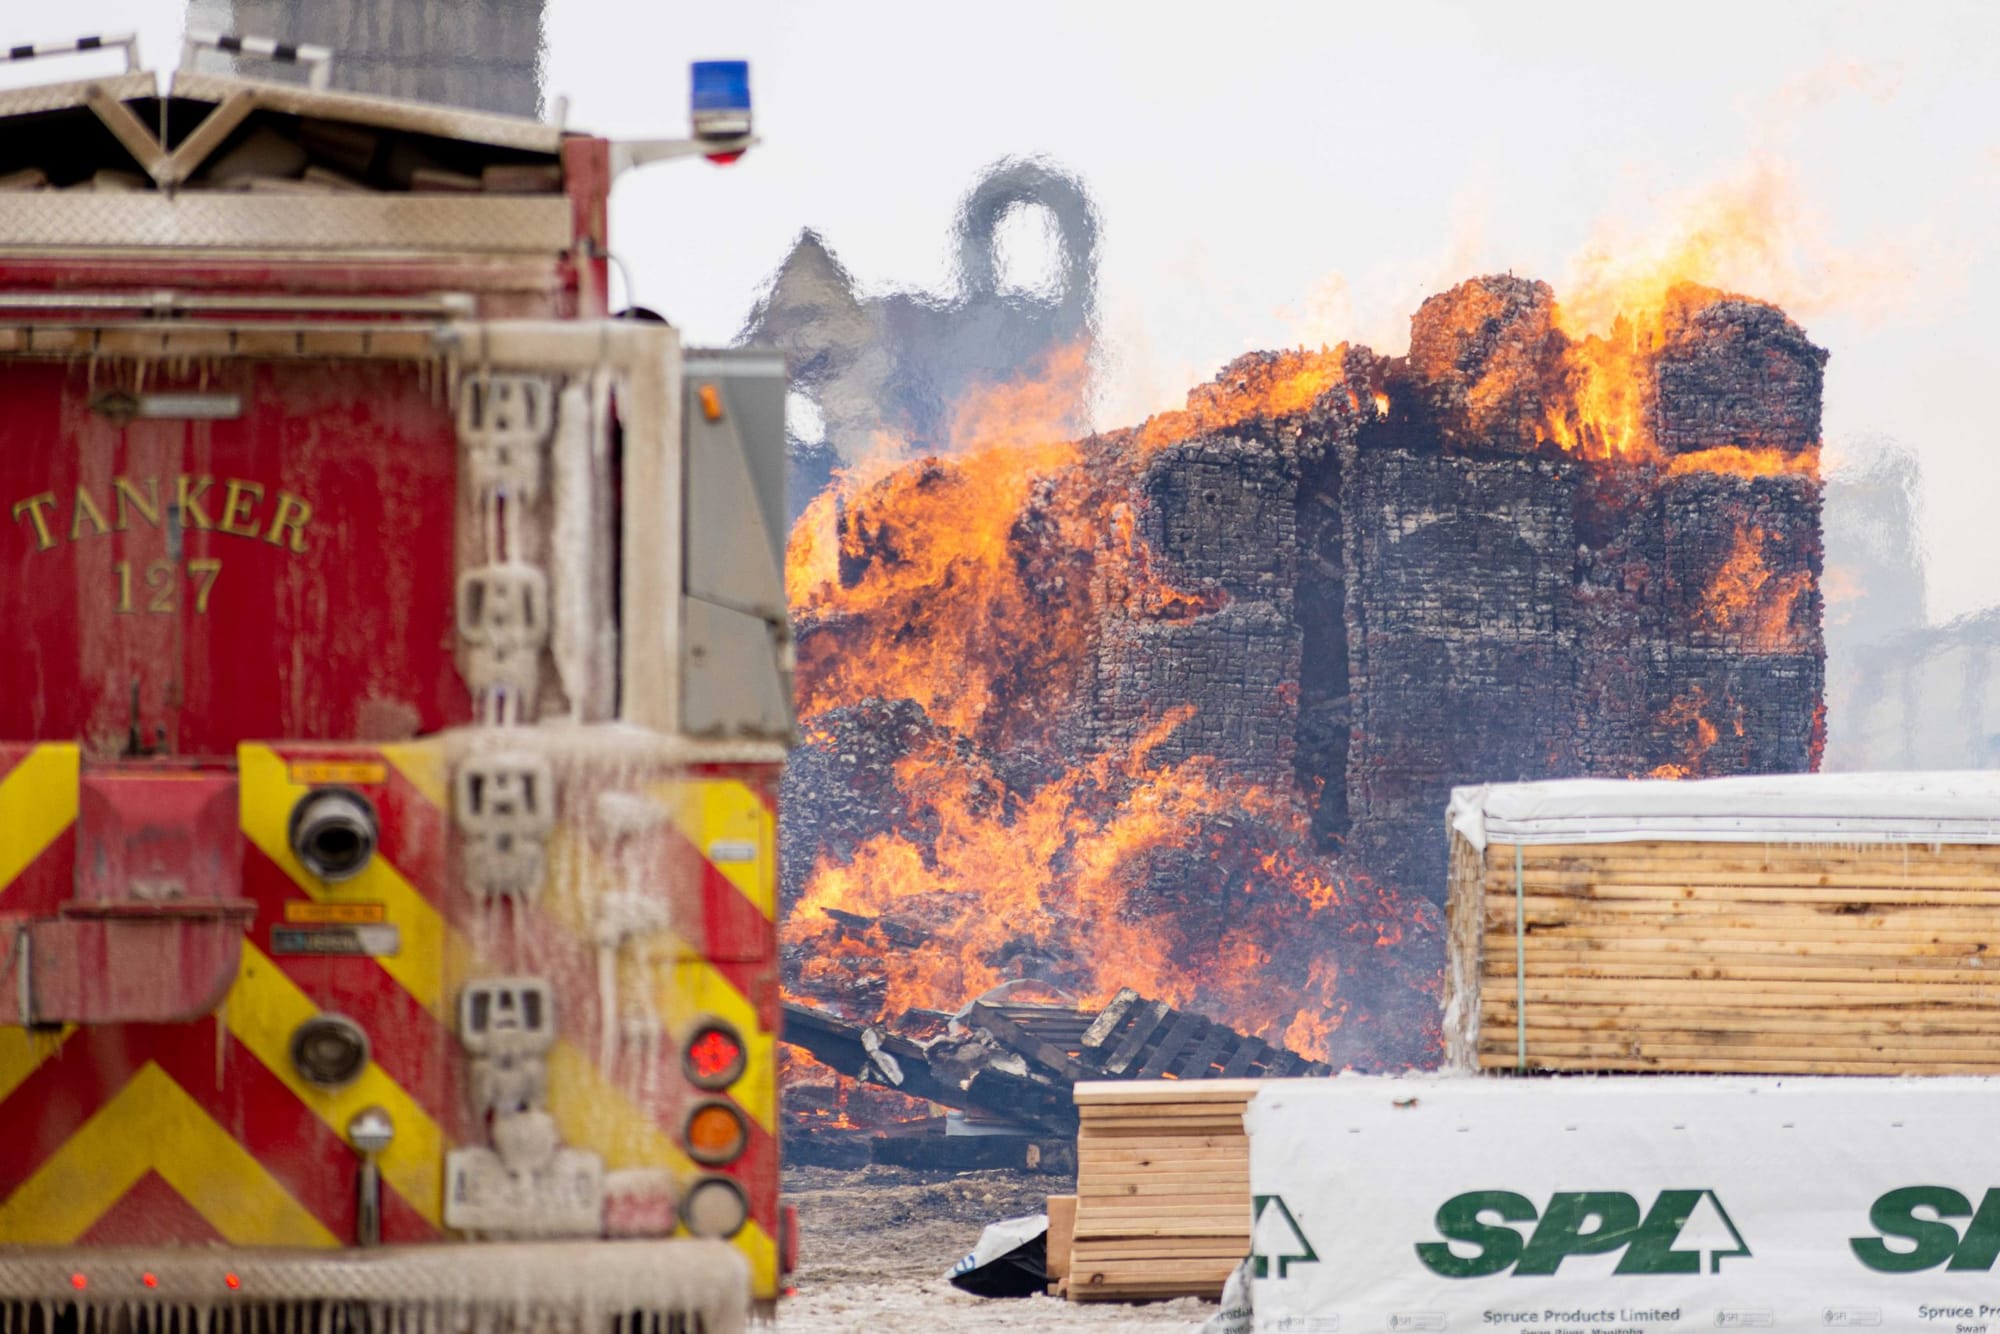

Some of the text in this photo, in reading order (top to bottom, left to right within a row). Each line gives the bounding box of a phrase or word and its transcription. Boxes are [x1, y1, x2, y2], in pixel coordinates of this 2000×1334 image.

[12, 473, 314, 553] TANKER
[113, 558, 223, 614] 127
[1414, 1189, 1752, 1279] SPL
[1483, 1308, 1681, 1324] Spruce Products Limited
[1917, 1305, 1974, 1320] Spruce
